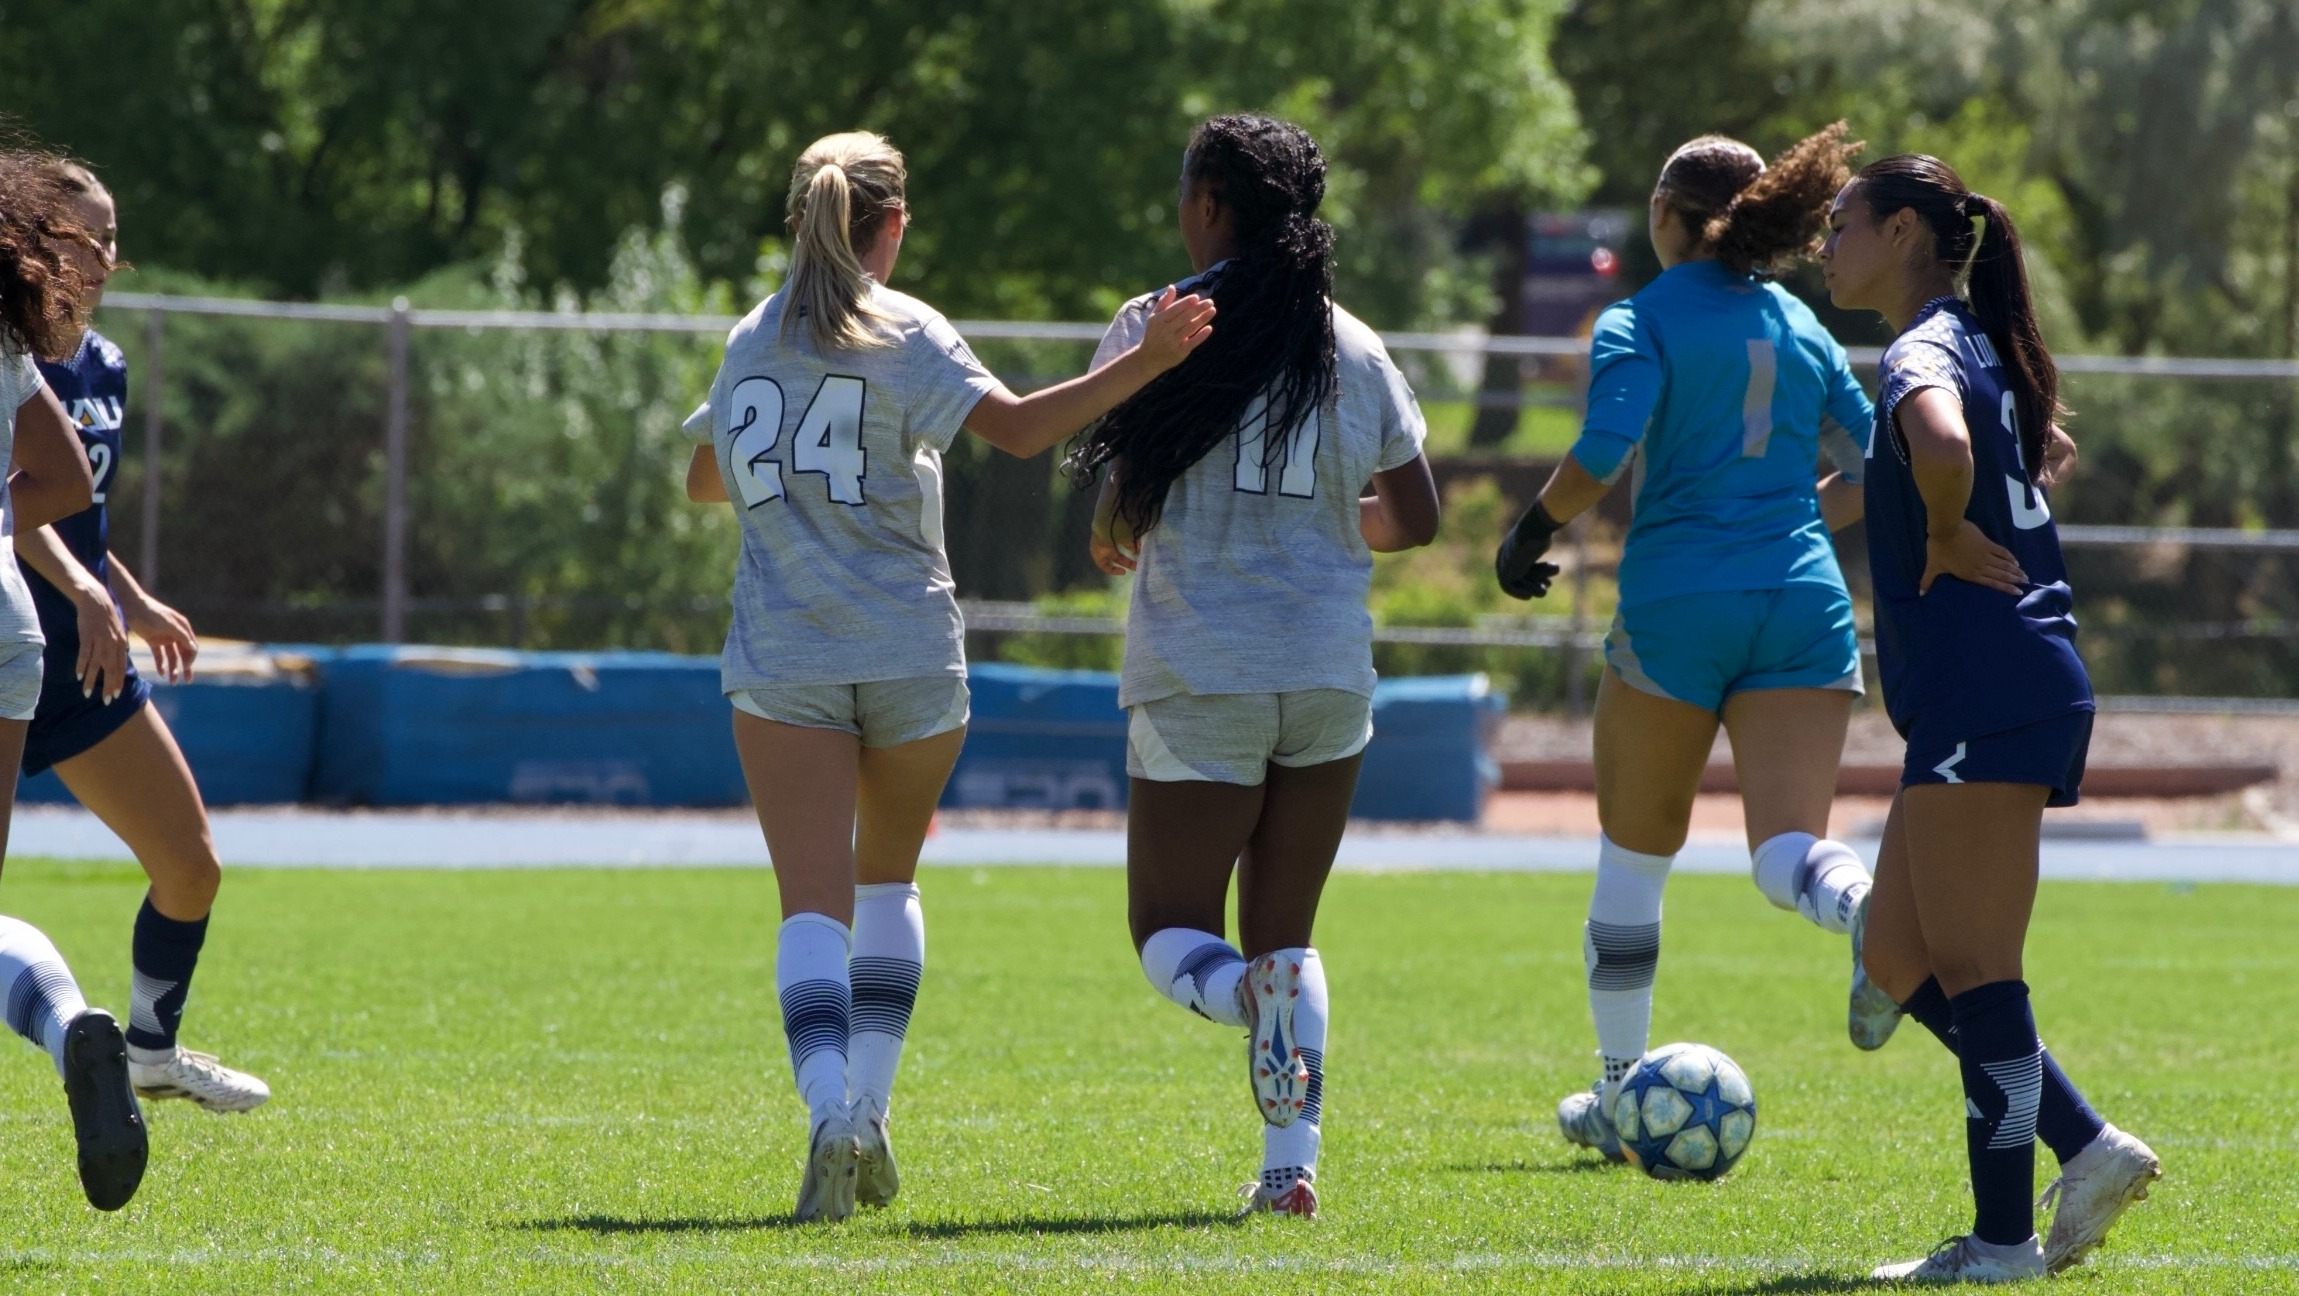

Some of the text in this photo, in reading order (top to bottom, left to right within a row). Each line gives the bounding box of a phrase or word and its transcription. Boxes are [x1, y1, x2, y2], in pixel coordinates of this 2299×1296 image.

[60, 395, 123, 431] AU
[727, 373, 867, 511] 24
[1742, 338, 1777, 458] 1
[84, 443, 111, 504] 2
[2001, 390, 2050, 530] 3
